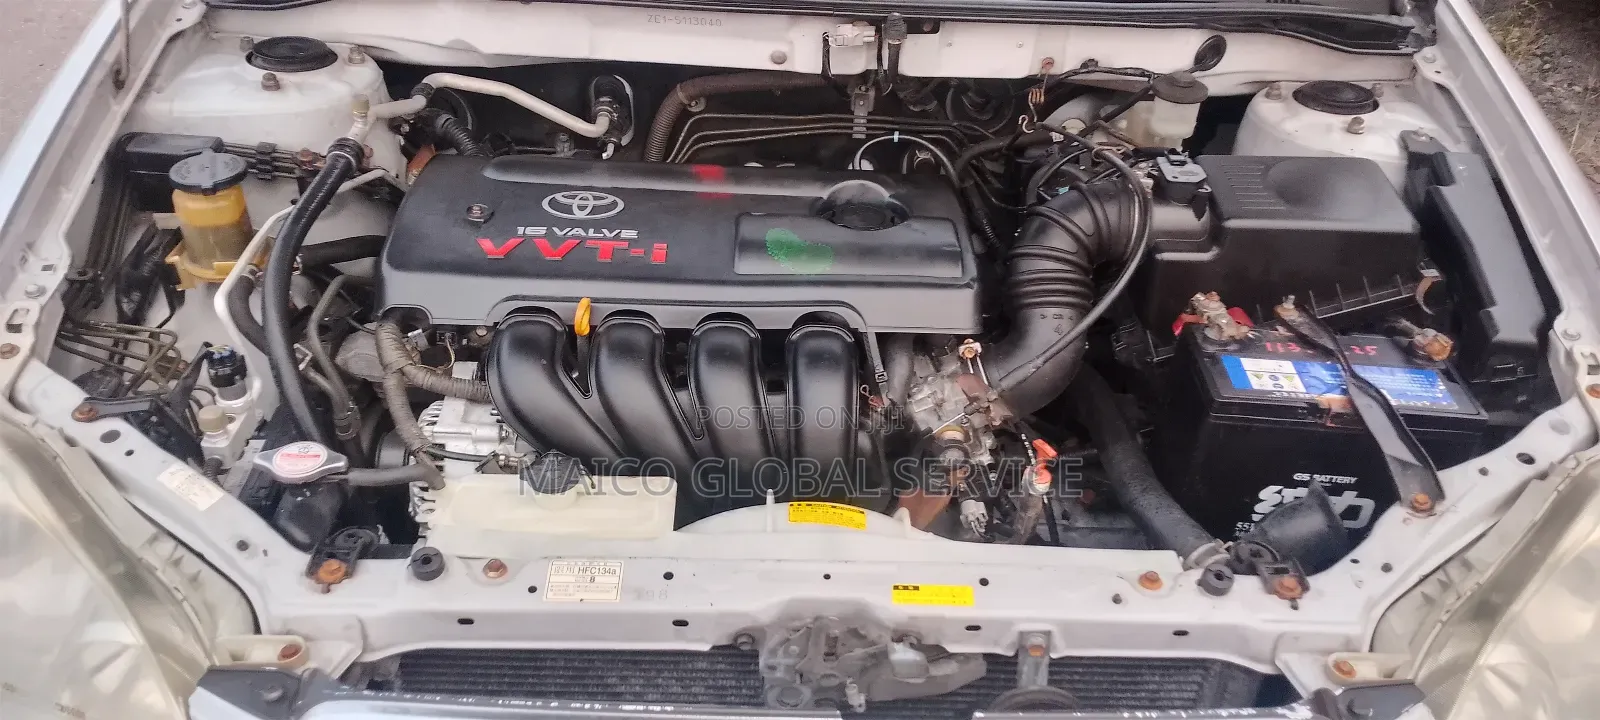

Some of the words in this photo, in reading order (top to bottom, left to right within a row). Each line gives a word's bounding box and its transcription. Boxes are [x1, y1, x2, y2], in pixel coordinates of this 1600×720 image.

[517, 226, 548, 237] 16
[552, 227, 639, 239] VALVE
[476, 238, 668, 265] VVT-i
[1293, 472, 1312, 481] GS
[1313, 474, 1359, 484] BATTERY
[577, 566, 617, 575] HFC134a
